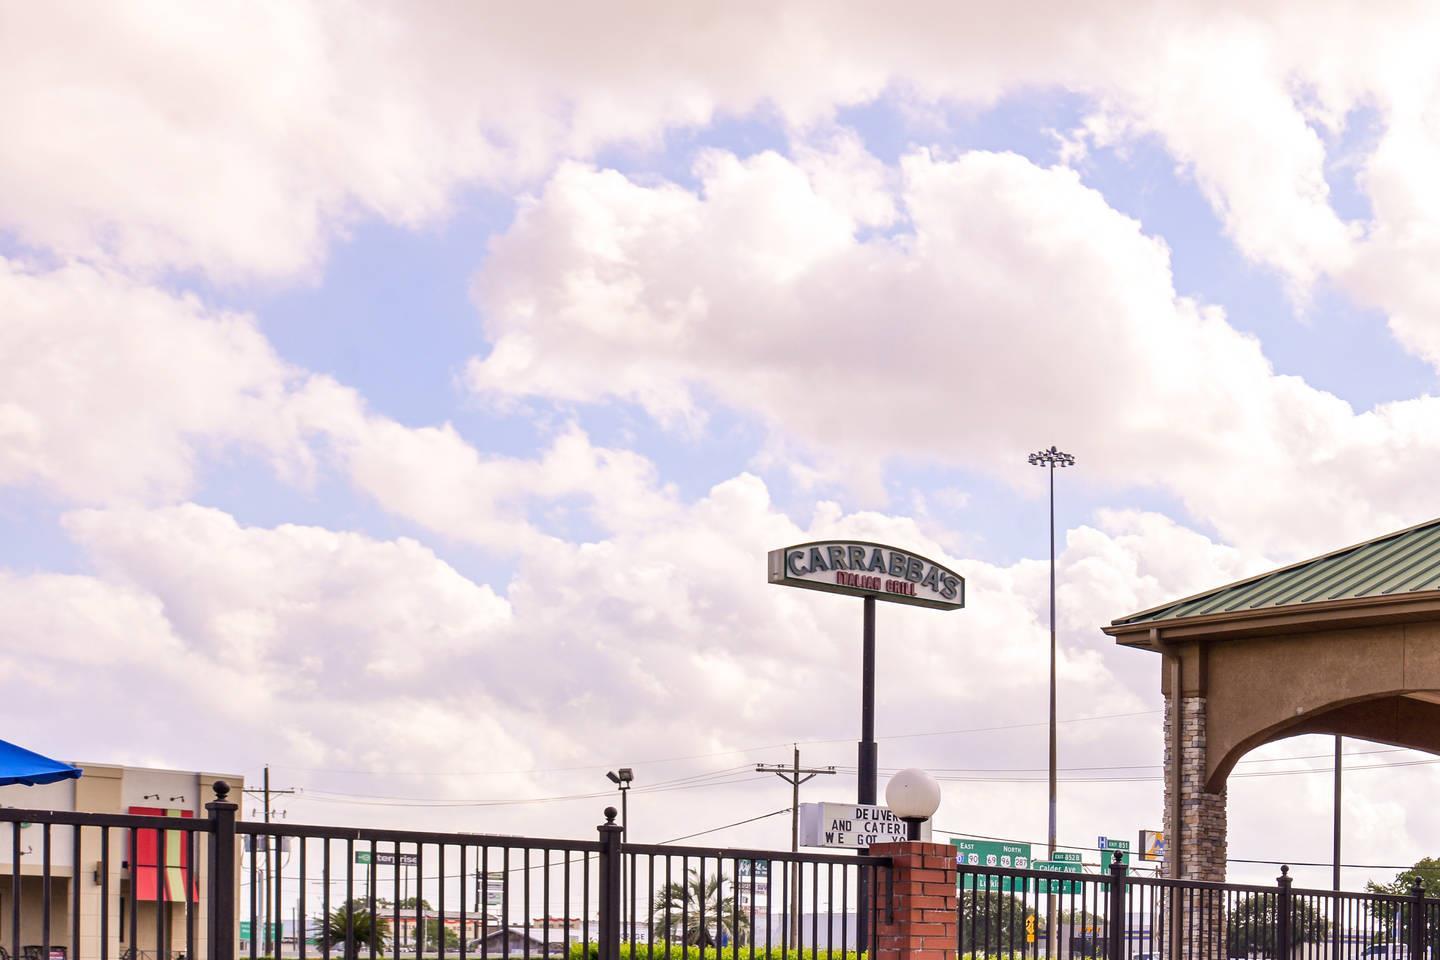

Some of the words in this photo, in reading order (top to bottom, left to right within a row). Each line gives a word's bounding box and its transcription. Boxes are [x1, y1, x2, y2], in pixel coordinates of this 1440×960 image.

[787, 545, 961, 600] CARRABBA'S
[836, 570, 882, 591] ITALIAN
[885, 577, 918, 597] GRILL
[855, 808, 902, 822] DELIVER
[831, 819, 852, 832] AND
[864, 821, 907, 835] CATERI
[825, 832, 845, 844] WE
[857, 834, 878, 846] GOT
[1099, 836, 1106, 848] H
[959, 842, 975, 850] EAST
[1003, 845, 1022, 853] NORTH
[969, 855, 978, 864] 90
[987, 856, 996, 864] 69
[1001, 857, 1010, 866] 96
[1015, 858, 1027, 867] 287
[1064, 853, 1080, 861] 852B
[1039, 864, 1062, 872] Calder
